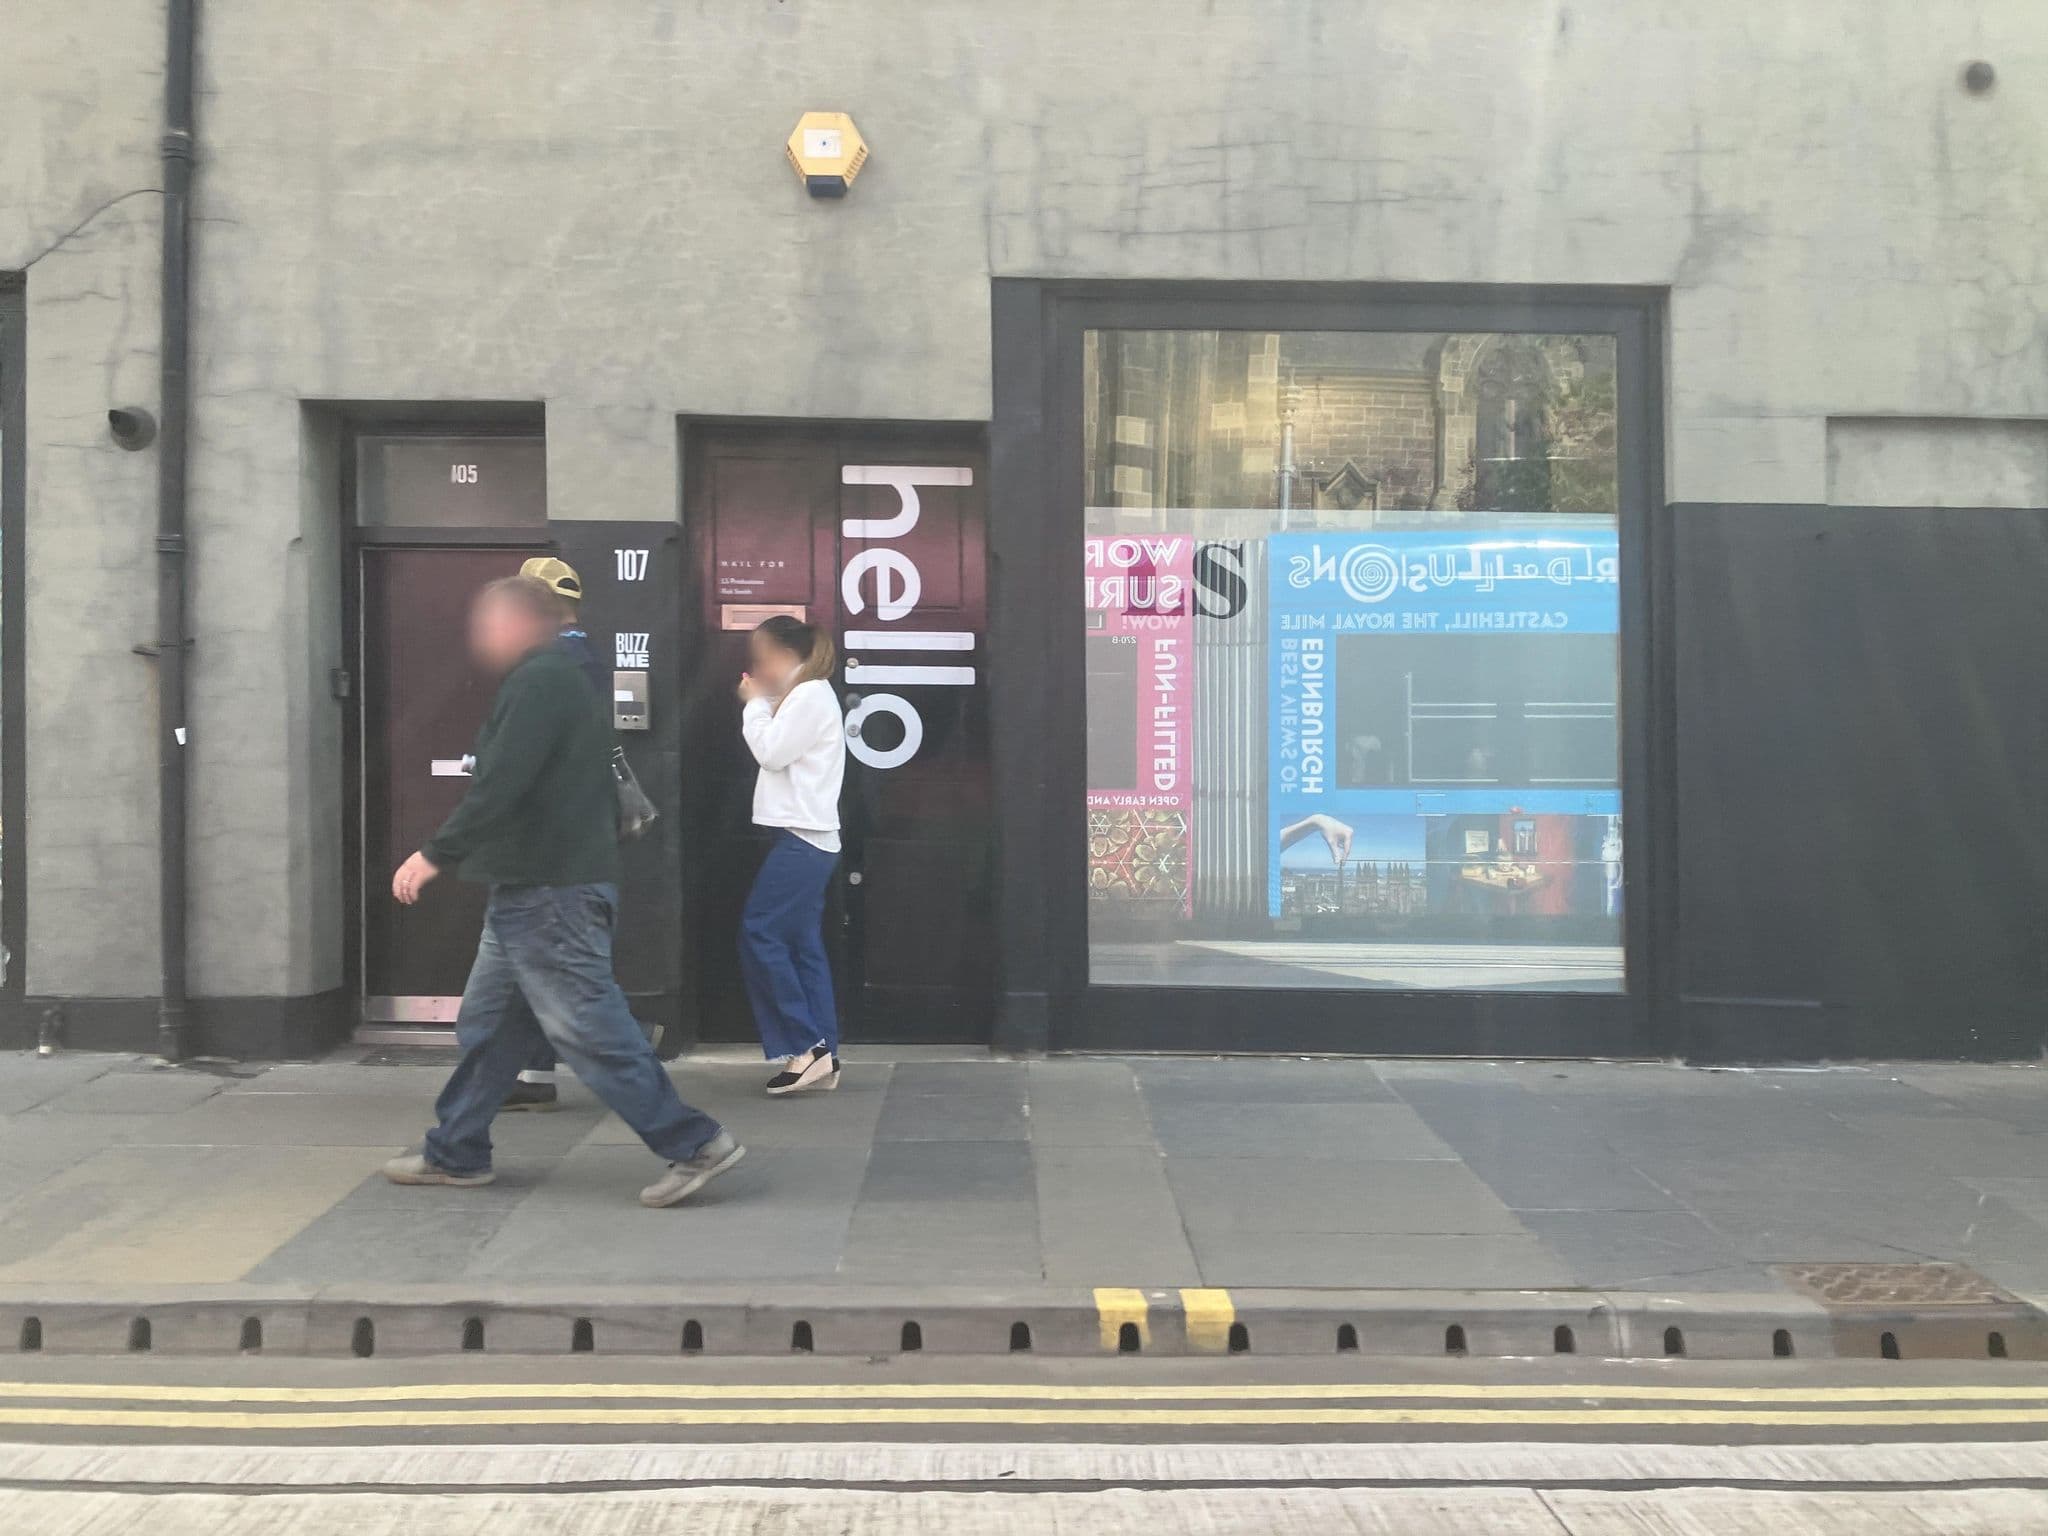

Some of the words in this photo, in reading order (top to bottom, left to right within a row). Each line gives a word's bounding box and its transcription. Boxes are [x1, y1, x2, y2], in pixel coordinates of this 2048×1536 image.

[452, 465, 478, 484] 105
[614, 550, 650, 581] 107
[721, 560, 752, 568] MAIL
[760, 560, 785, 568] FOR
[841, 464, 976, 770] hello
[615, 633, 650, 654] BUZZ
[616, 654, 650, 668] ME
